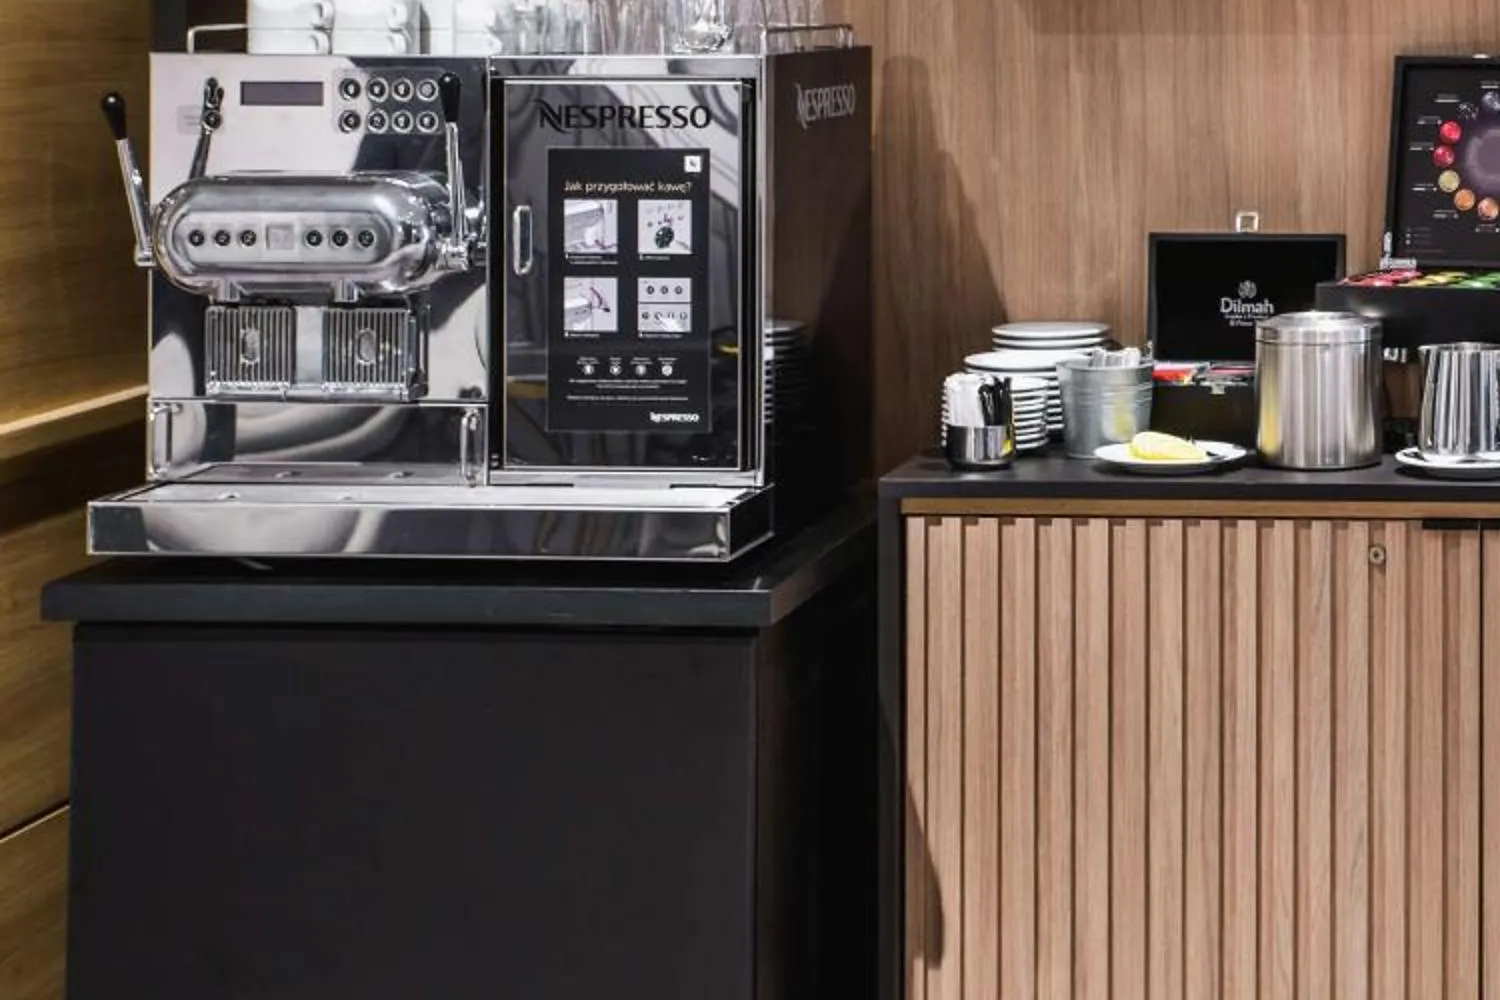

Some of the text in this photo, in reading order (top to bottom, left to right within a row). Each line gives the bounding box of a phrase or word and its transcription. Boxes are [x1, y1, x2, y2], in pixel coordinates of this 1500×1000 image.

[535, 99, 712, 134] NESPRESSO
[564, 180, 582, 192] Jak
[1220, 297, 1274, 314] Dilmah
